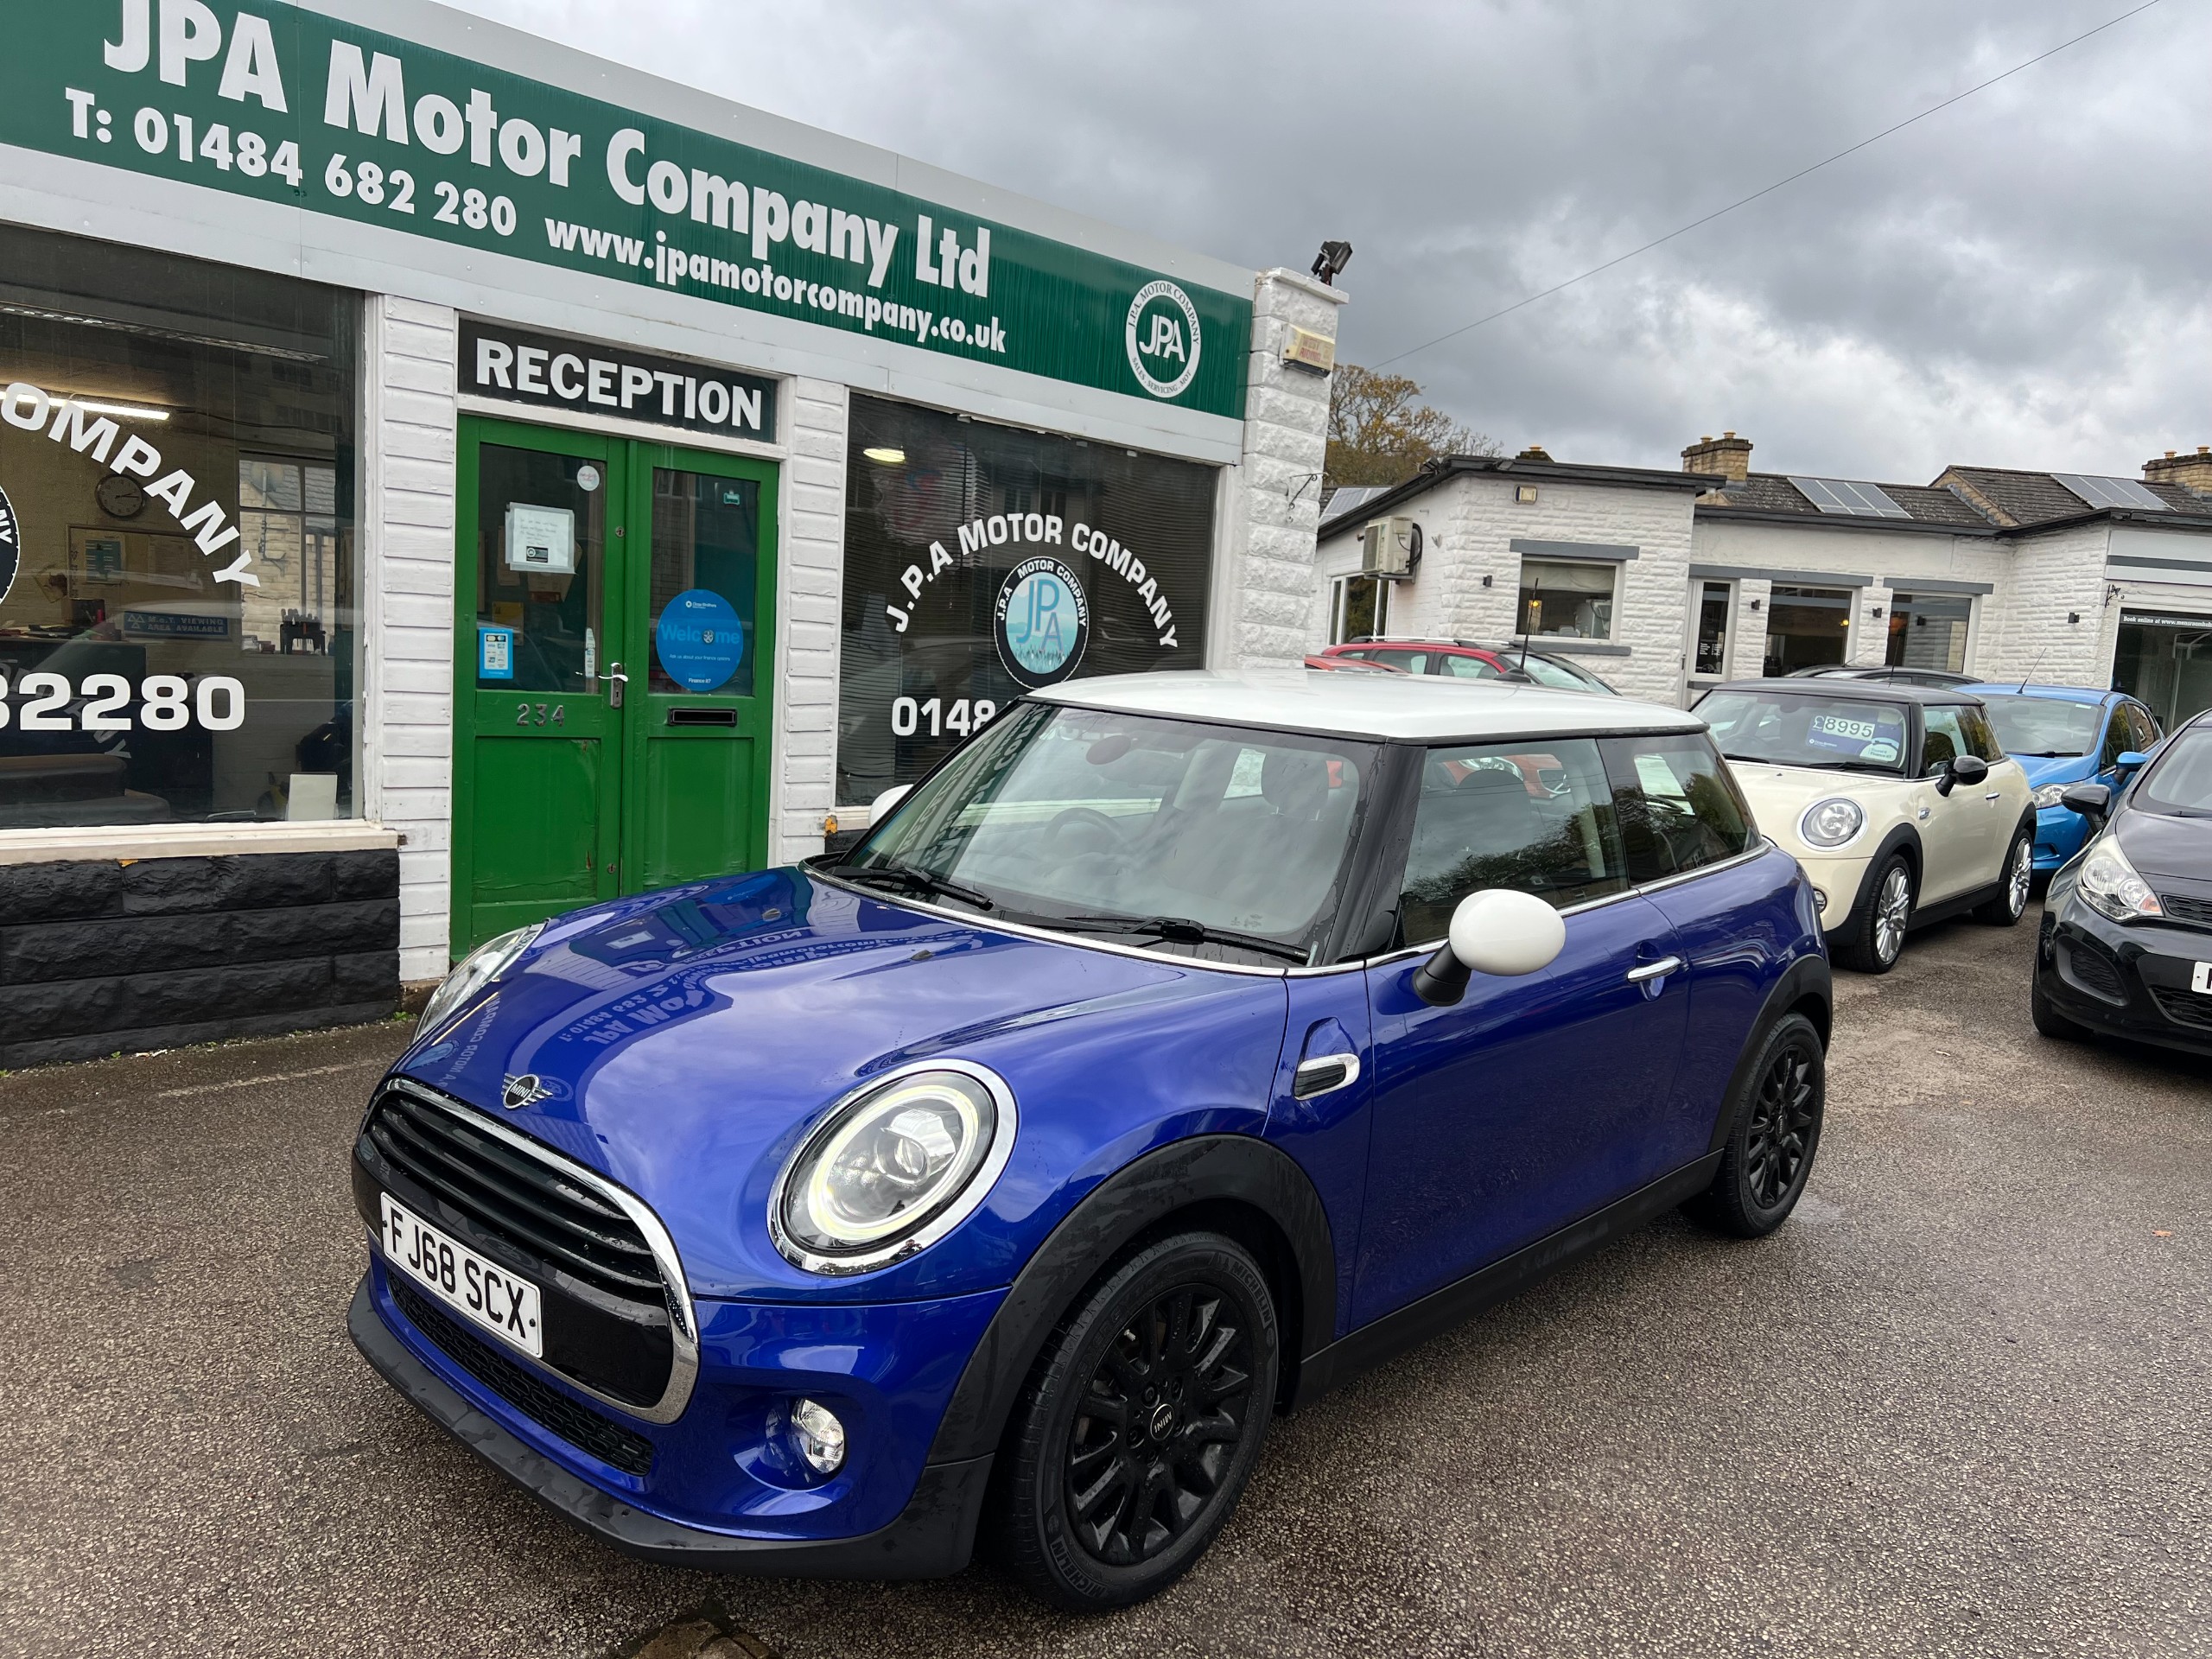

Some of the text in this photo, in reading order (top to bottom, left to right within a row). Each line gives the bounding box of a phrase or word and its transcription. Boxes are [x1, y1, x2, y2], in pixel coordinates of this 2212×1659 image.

[65, 86, 517, 236] T: 01484 682 280
[104, 0, 990, 299] JPA Motor Company Ltd
[545, 217, 1007, 354] www.jpamotorcompany.co.uk
[1140, 282, 1173, 302] MOTOR
[1173, 289, 1199, 346] COMPANY
[1138, 314, 1186, 363] JPA
[476, 337, 762, 430] RECEPTION
[1147, 379, 1178, 394] SERVICING
[1179, 370, 1192, 387] MOT
[886, 512, 1179, 648] J.P.A MOTOR COMPANY
[996, 559, 1087, 626] J.P.A MOTOR COMPANY
[175, 625, 224, 633] AVAILABLE
[660, 623, 741, 645] Welcme
[1015, 578, 1064, 653] JPA
[0, 672, 245, 732] 2280
[517, 702, 565, 727] 234
[891, 696, 1011, 736] 0148
[1812, 715, 1873, 738] £8995
[510, 1083, 531, 1098] MINI
[391, 1206, 526, 1339] FJ68 SCX
[1230, 1262, 1273, 1325] MICHELIN
[1154, 1411, 1173, 1433] MINI
[1050, 1541, 1106, 1598] MICHELIN
